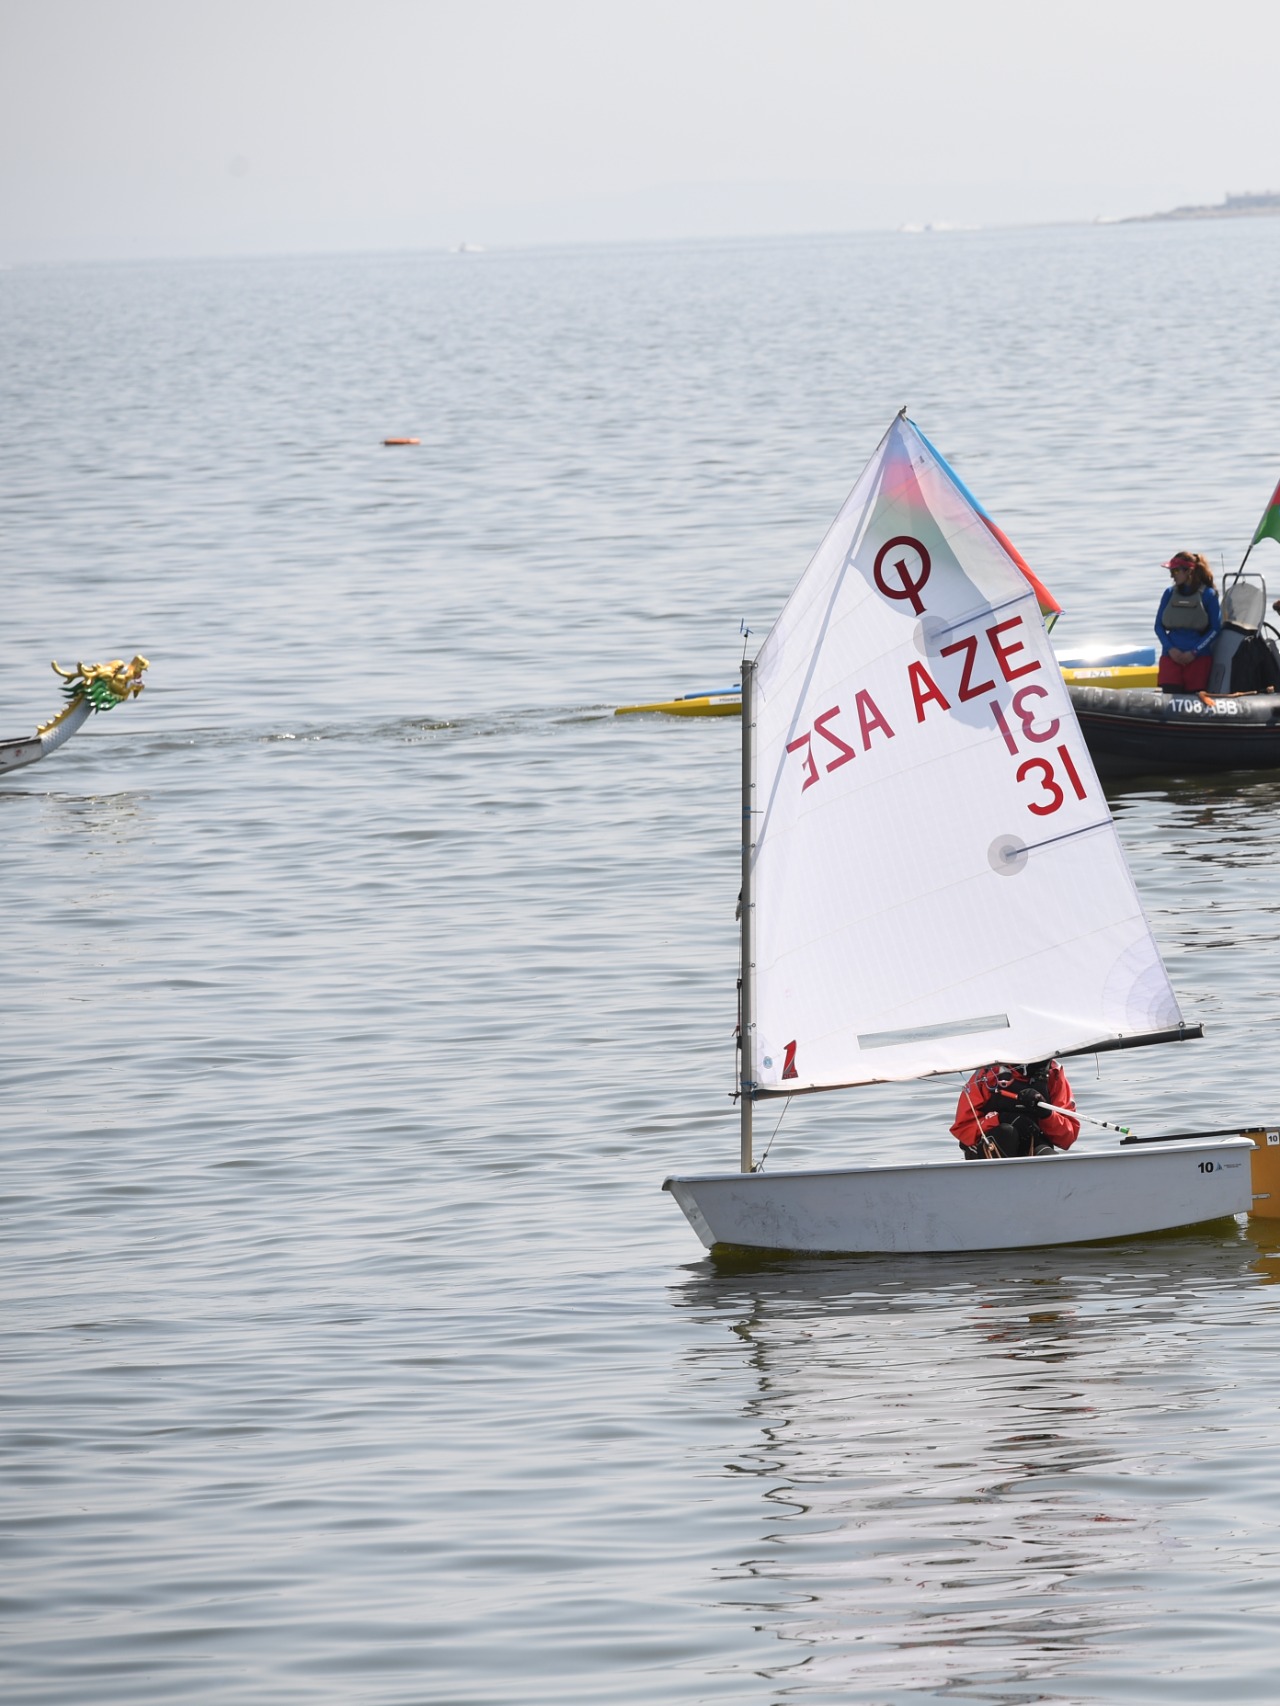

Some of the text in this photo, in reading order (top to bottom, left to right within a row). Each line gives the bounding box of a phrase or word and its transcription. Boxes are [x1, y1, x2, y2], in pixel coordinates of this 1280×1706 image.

[908, 615, 1042, 723] AZE
[1169, 698, 1202, 713] 1708
[1016, 744, 1087, 816] 31
[1197, 1162, 1214, 1173] 10
